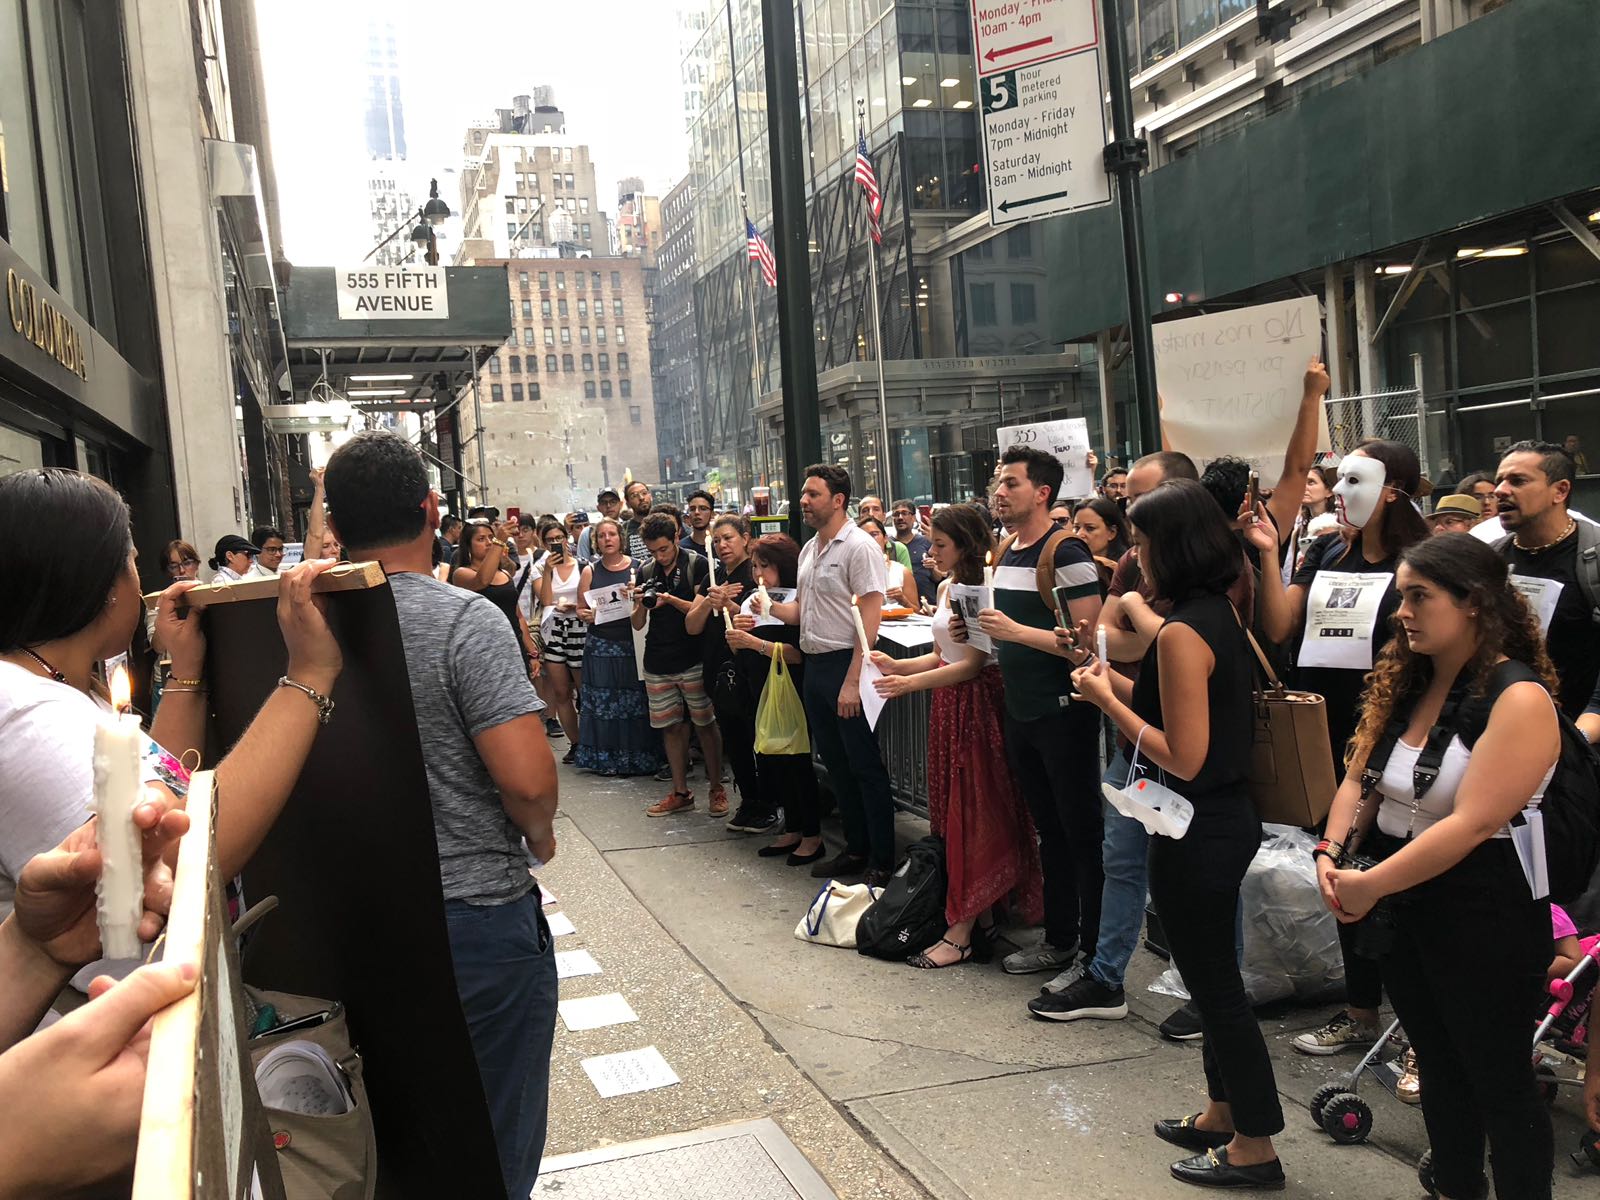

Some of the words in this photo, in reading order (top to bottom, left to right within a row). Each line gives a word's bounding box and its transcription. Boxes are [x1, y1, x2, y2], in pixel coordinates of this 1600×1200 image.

[979, 2, 1020, 22] Monday
[981, 21, 1008, 37] 10am
[1018, 11, 1042, 28] 4pm
[990, 75, 1009, 109] 5
[1020, 69, 1042, 81] hour
[1021, 75, 1061, 94] metered
[1022, 89, 1058, 107] parking
[989, 117, 1030, 136] Monday
[1041, 106, 1076, 122] Friday
[990, 137, 1013, 151] 7pm
[1024, 122, 1069, 142] Midnight
[992, 152, 1041, 172] Saturday
[994, 173, 1017, 187] 8am
[1027, 160, 1073, 179] Midnight
[347, 273, 379, 289] 555
[385, 273, 438, 289] FIFTH
[355, 296, 433, 311] AVENUE
[7, 267, 88, 382] COLOMBIA
[1052, 445, 1071, 454] Two
